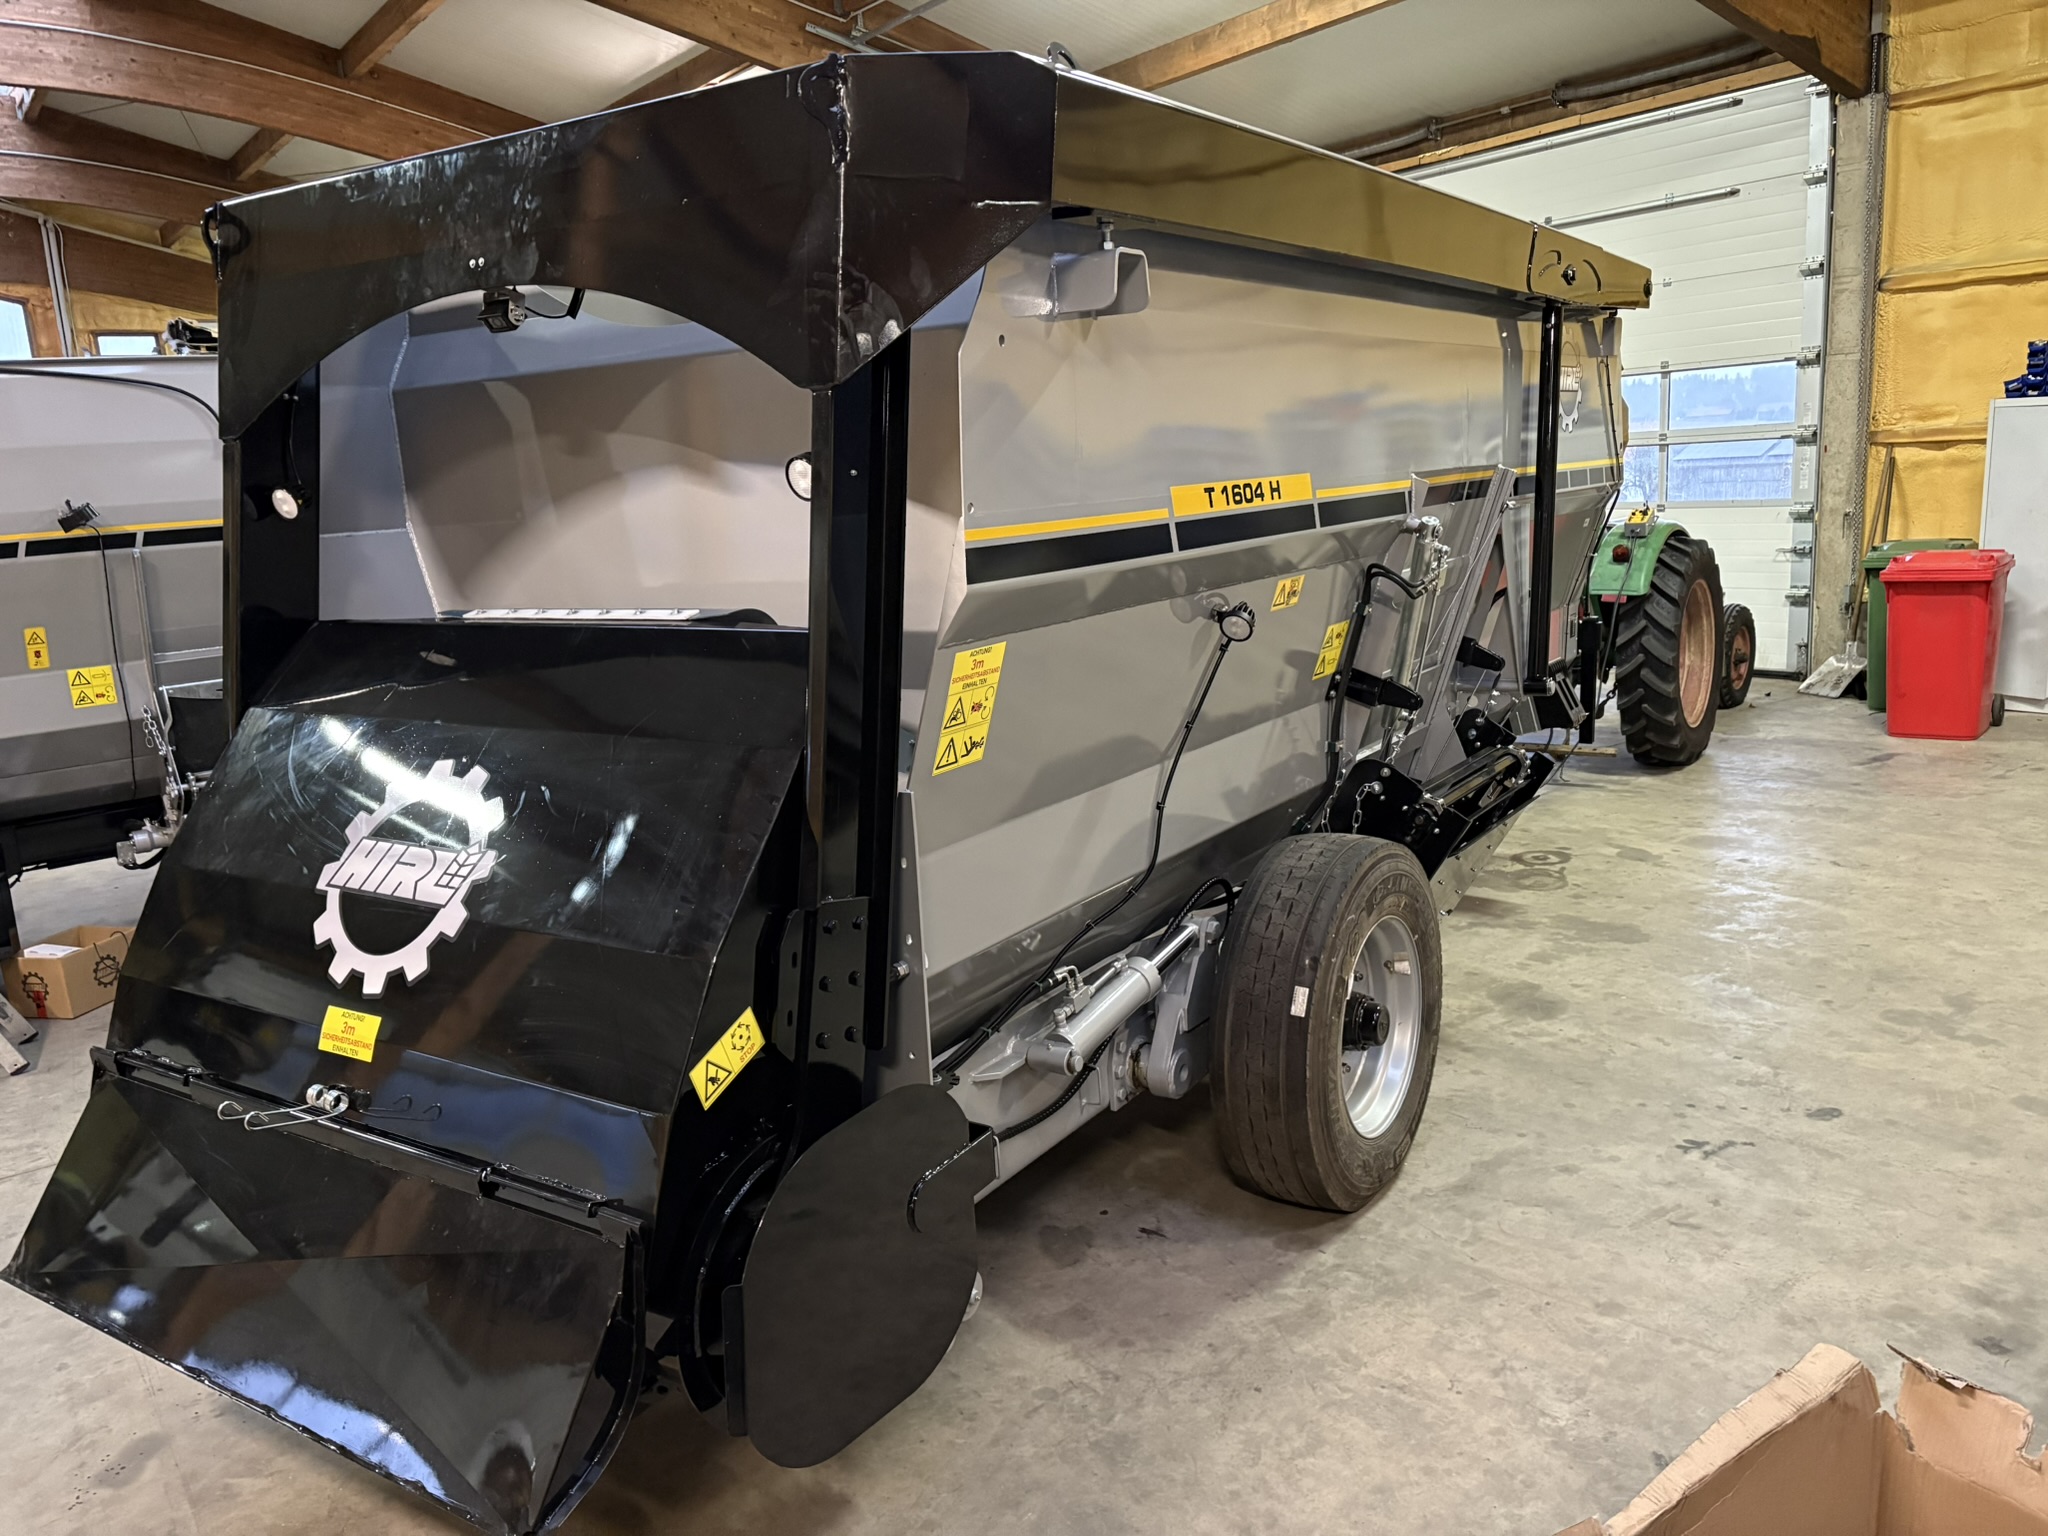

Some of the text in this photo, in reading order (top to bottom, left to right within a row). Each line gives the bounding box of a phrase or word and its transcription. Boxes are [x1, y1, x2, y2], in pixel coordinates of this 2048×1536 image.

[1204, 480, 1281, 508] T 1604 H
[971, 659, 984, 671] 3m
[962, 678, 987, 690] EINHALTEN
[341, 1021, 356, 1036] 3m
[332, 1044, 359, 1056] EINHALTEN
[740, 1043, 755, 1062] STOP
